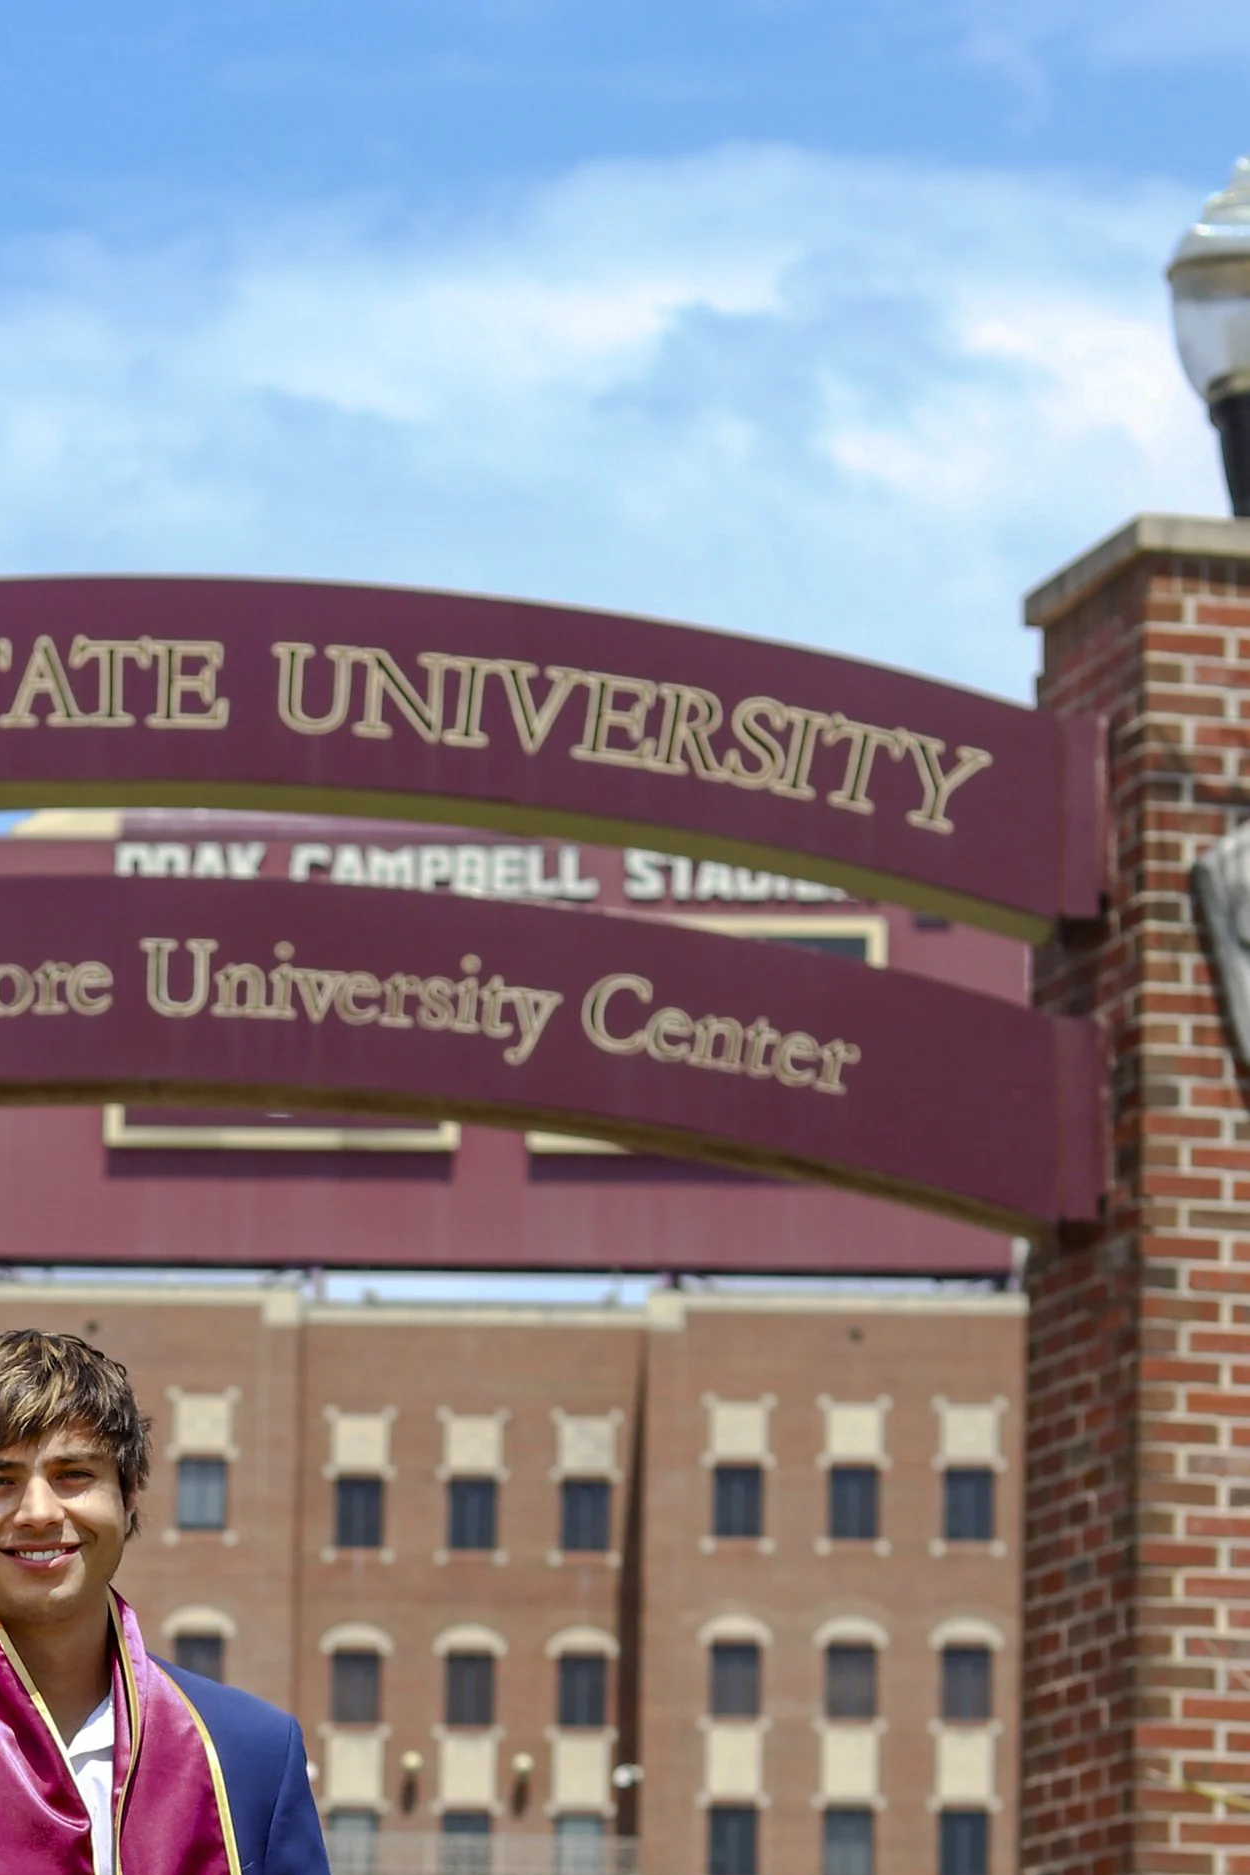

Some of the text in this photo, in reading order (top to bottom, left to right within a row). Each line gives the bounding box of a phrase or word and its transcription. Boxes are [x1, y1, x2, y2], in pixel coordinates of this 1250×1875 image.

[271, 641, 993, 833] UNIVERSITY
[288, 843, 599, 899] CAMPBELL
[622, 846, 856, 902] STAD
[140, 938, 563, 1066] University
[580, 974, 862, 1096] Center
